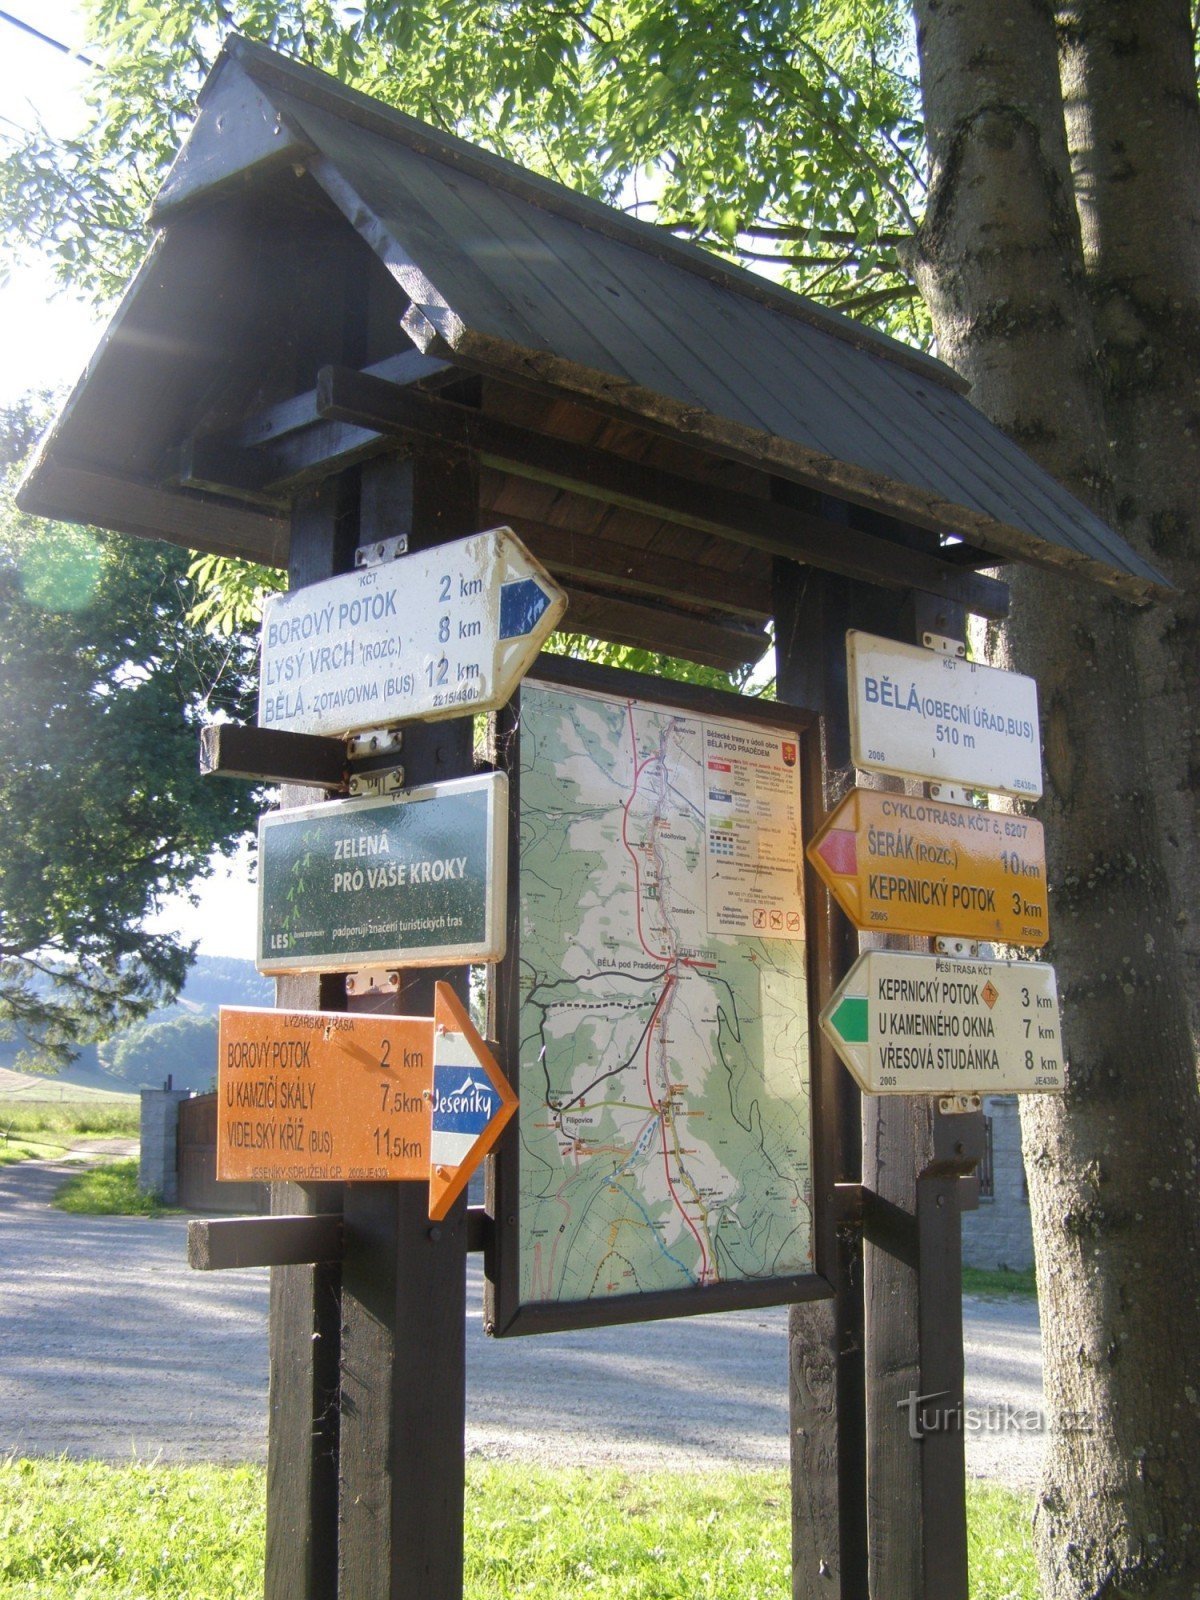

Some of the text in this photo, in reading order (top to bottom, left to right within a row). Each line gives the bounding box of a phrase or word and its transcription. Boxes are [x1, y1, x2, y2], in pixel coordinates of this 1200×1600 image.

[359, 572, 377, 587] KČT
[268, 575, 482, 648] BOROVÝ POTOK 2 km
[267, 648, 304, 685] LYSÝ
[309, 640, 354, 674] VRCH
[439, 616, 450, 643] 8
[459, 619, 481, 638] km
[943, 657, 957, 670] KČT
[383, 673, 415, 701] (BUS)
[426, 659, 449, 687] 12
[457, 662, 479, 681] km
[865, 676, 921, 715] BĚLÁ
[922, 698, 970, 725] (OBECNÍ
[707, 739, 770, 756] BĚLÁ POD PRADĚDEM
[731, 734, 745, 745] trasy
[936, 724, 975, 748] 510 m
[868, 750, 885, 761] 2006
[882, 802, 1027, 839] CYKLOTRASA KČT č. 6207
[334, 829, 390, 860] ZELENÁ
[868, 824, 914, 860] ŠERÁK
[1001, 851, 1020, 876] 10
[1022, 859, 1040, 878] km
[333, 857, 468, 893] PRO VAŠE KROKY
[672, 906, 695, 915] Domašov
[869, 876, 1042, 918] KEPRNICKÝ POTOK 3 km
[400, 915, 445, 932] turistických
[447, 914, 463, 927] tras
[597, 958, 666, 970] BĚLÁ pod Pradědem
[953, 964, 977, 975] TRASA
[978, 964, 992, 976] KČT
[879, 977, 1052, 1008] KEPRNICKÝ POTOK 3 km
[879, 1010, 1055, 1039] U KAMENNÉHO OKNA 7 km
[228, 1036, 423, 1068] BOROVÝ POTOK 2 km
[880, 1042, 1057, 1070] VŘESOVÁ STUDÁNKA 8 km
[227, 1083, 235, 1107] U
[236, 1075, 278, 1107] KAMZIČÍ
[280, 1076, 315, 1110] SKÁLY
[880, 1076, 897, 1086] 2005
[433, 1089, 491, 1120] Jeseníky
[566, 1117, 593, 1125] Filipovice
[227, 1116, 276, 1149] VIDELSKÝ
[279, 1117, 304, 1151] KŘÍŽ
[309, 1131, 333, 1158] (BUS)
